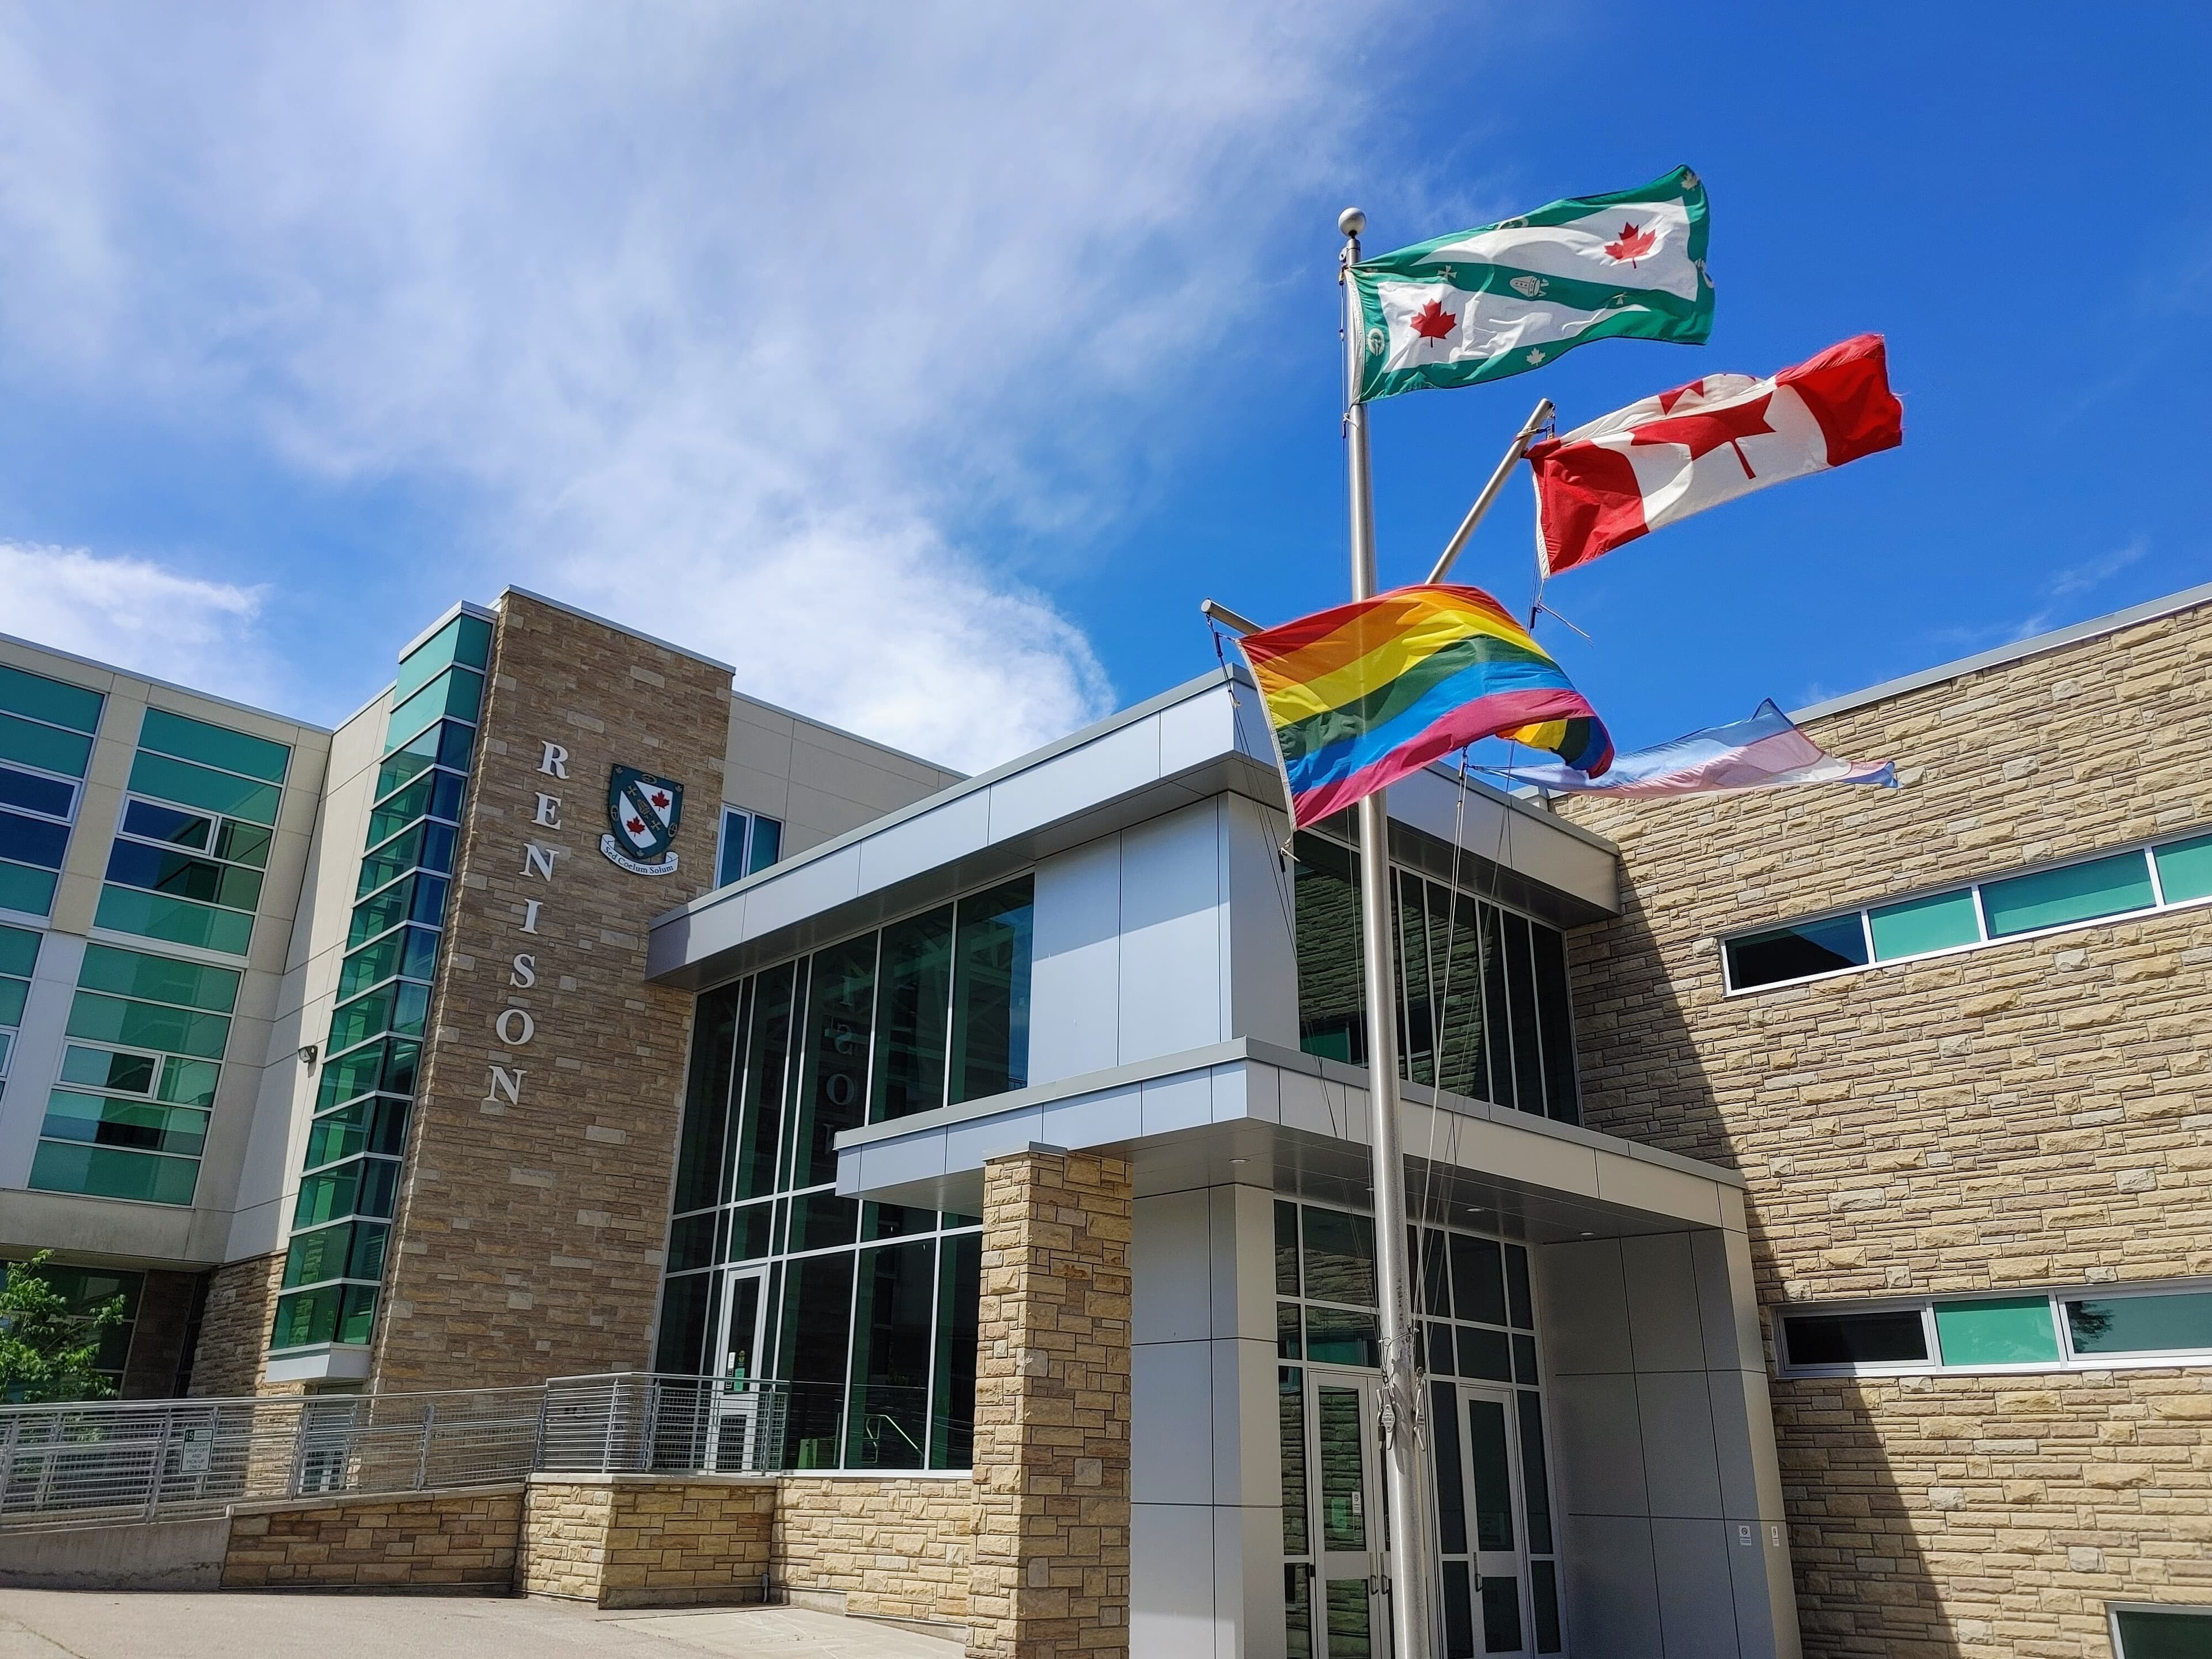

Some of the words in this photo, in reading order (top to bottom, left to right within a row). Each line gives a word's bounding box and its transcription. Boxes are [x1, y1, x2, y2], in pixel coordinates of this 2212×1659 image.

[605, 846, 618, 860] Sed
[618, 857, 648, 873] Coelum
[649, 865, 674, 874] Solum
[484, 741, 569, 1105] RENISON
[185, 1431, 194, 1440] 15
